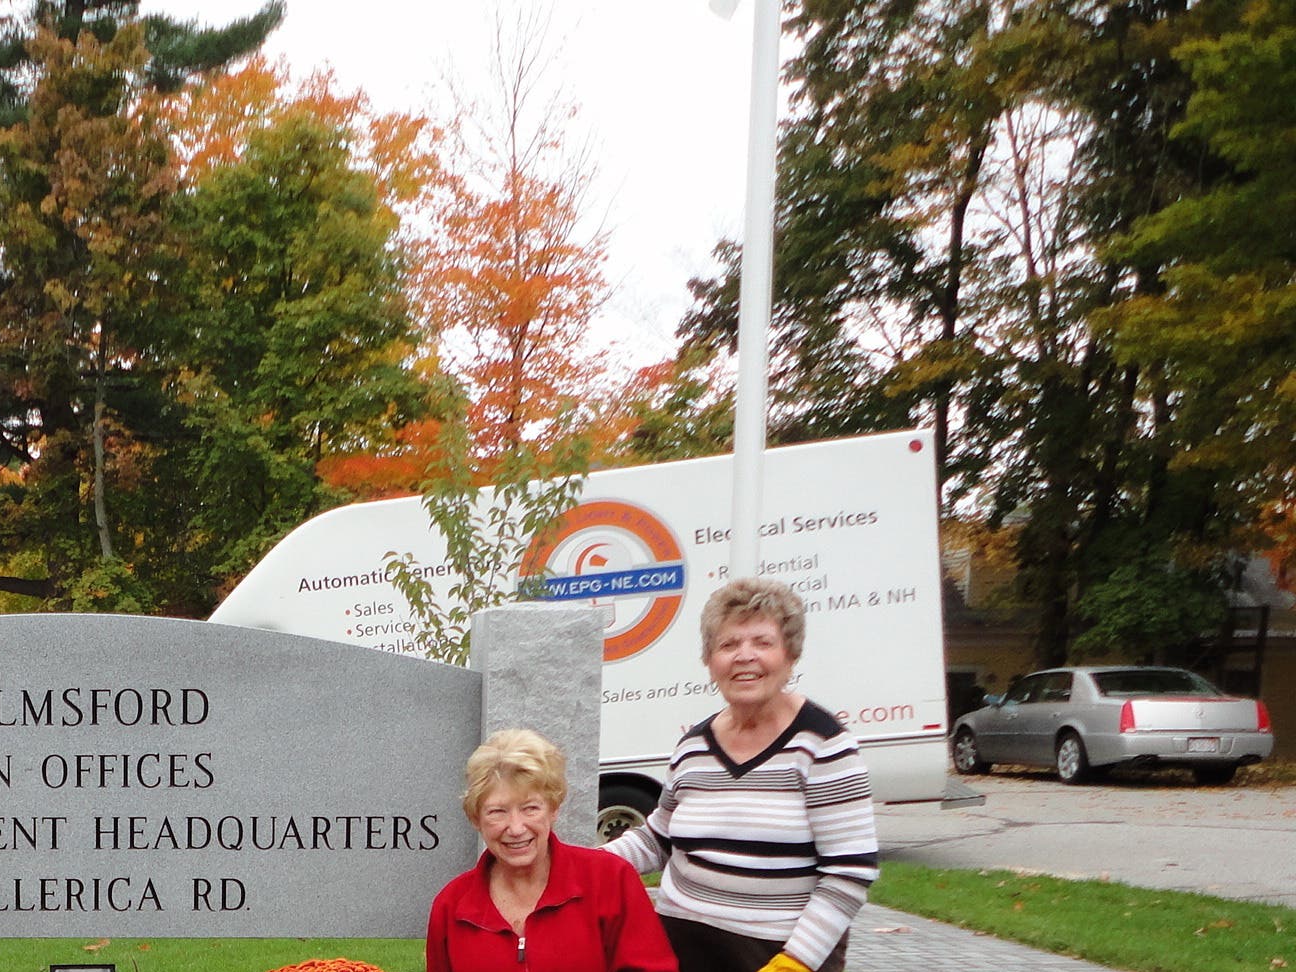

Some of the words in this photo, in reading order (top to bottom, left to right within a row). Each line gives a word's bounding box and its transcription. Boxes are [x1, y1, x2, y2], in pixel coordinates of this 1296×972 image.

[694, 518, 785, 545] Eleccal
[792, 509, 878, 533] Services
[298, 567, 394, 593] Automatic
[354, 601, 394, 617] Sales
[828, 594, 861, 610] MA
[868, 592, 881, 606] &
[887, 588, 916, 604] NH
[356, 619, 412, 638] Service
[602, 688, 641, 704] Sales
[646, 683, 679, 700] and
[41, 752, 214, 790] OFFICES
[93, 814, 441, 853] HEADQUARTERS
[191, 878, 251, 913] RD.
